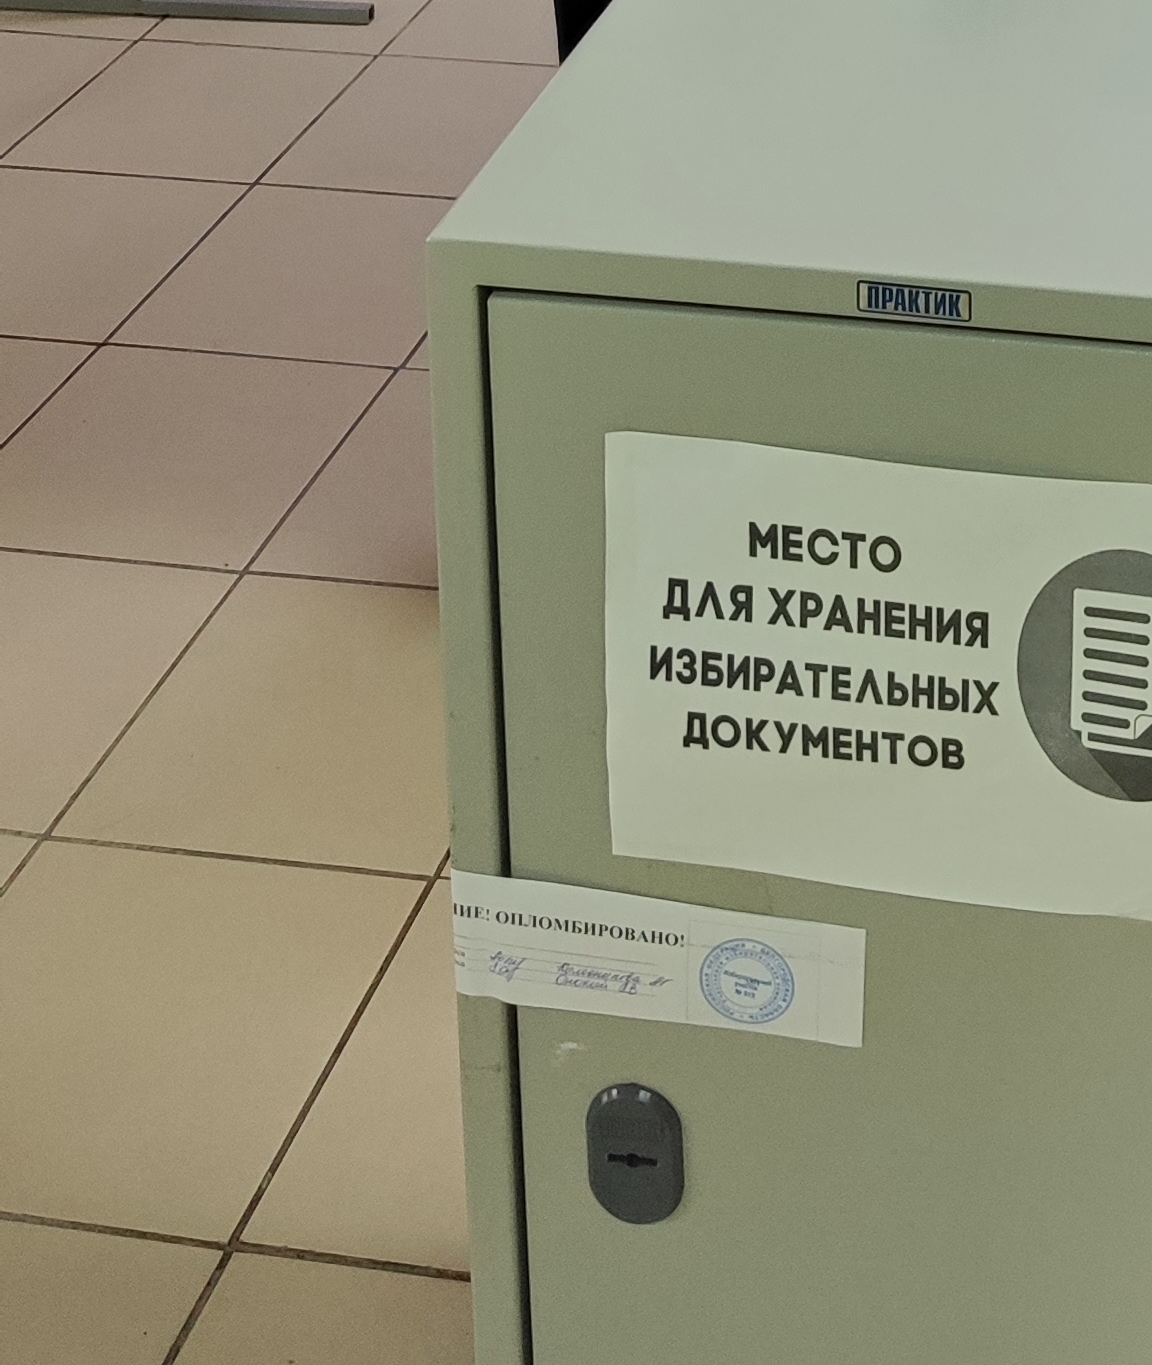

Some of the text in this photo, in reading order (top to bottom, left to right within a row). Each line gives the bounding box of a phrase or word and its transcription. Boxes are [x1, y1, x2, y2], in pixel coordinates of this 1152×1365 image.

[865, 285, 963, 320] ПРАКТИК
[747, 520, 903, 574] МЕСТО
[662, 576, 990, 649] ДЛЯ ХРАНЕНИЯ
[648, 645, 1001, 717] ИЗБИРАТЕЛЬНЫХ
[682, 711, 966, 771] ДОКУМЕНТОВ
[495, 910, 686, 948] ОПЛОМБИРОВАНО!
